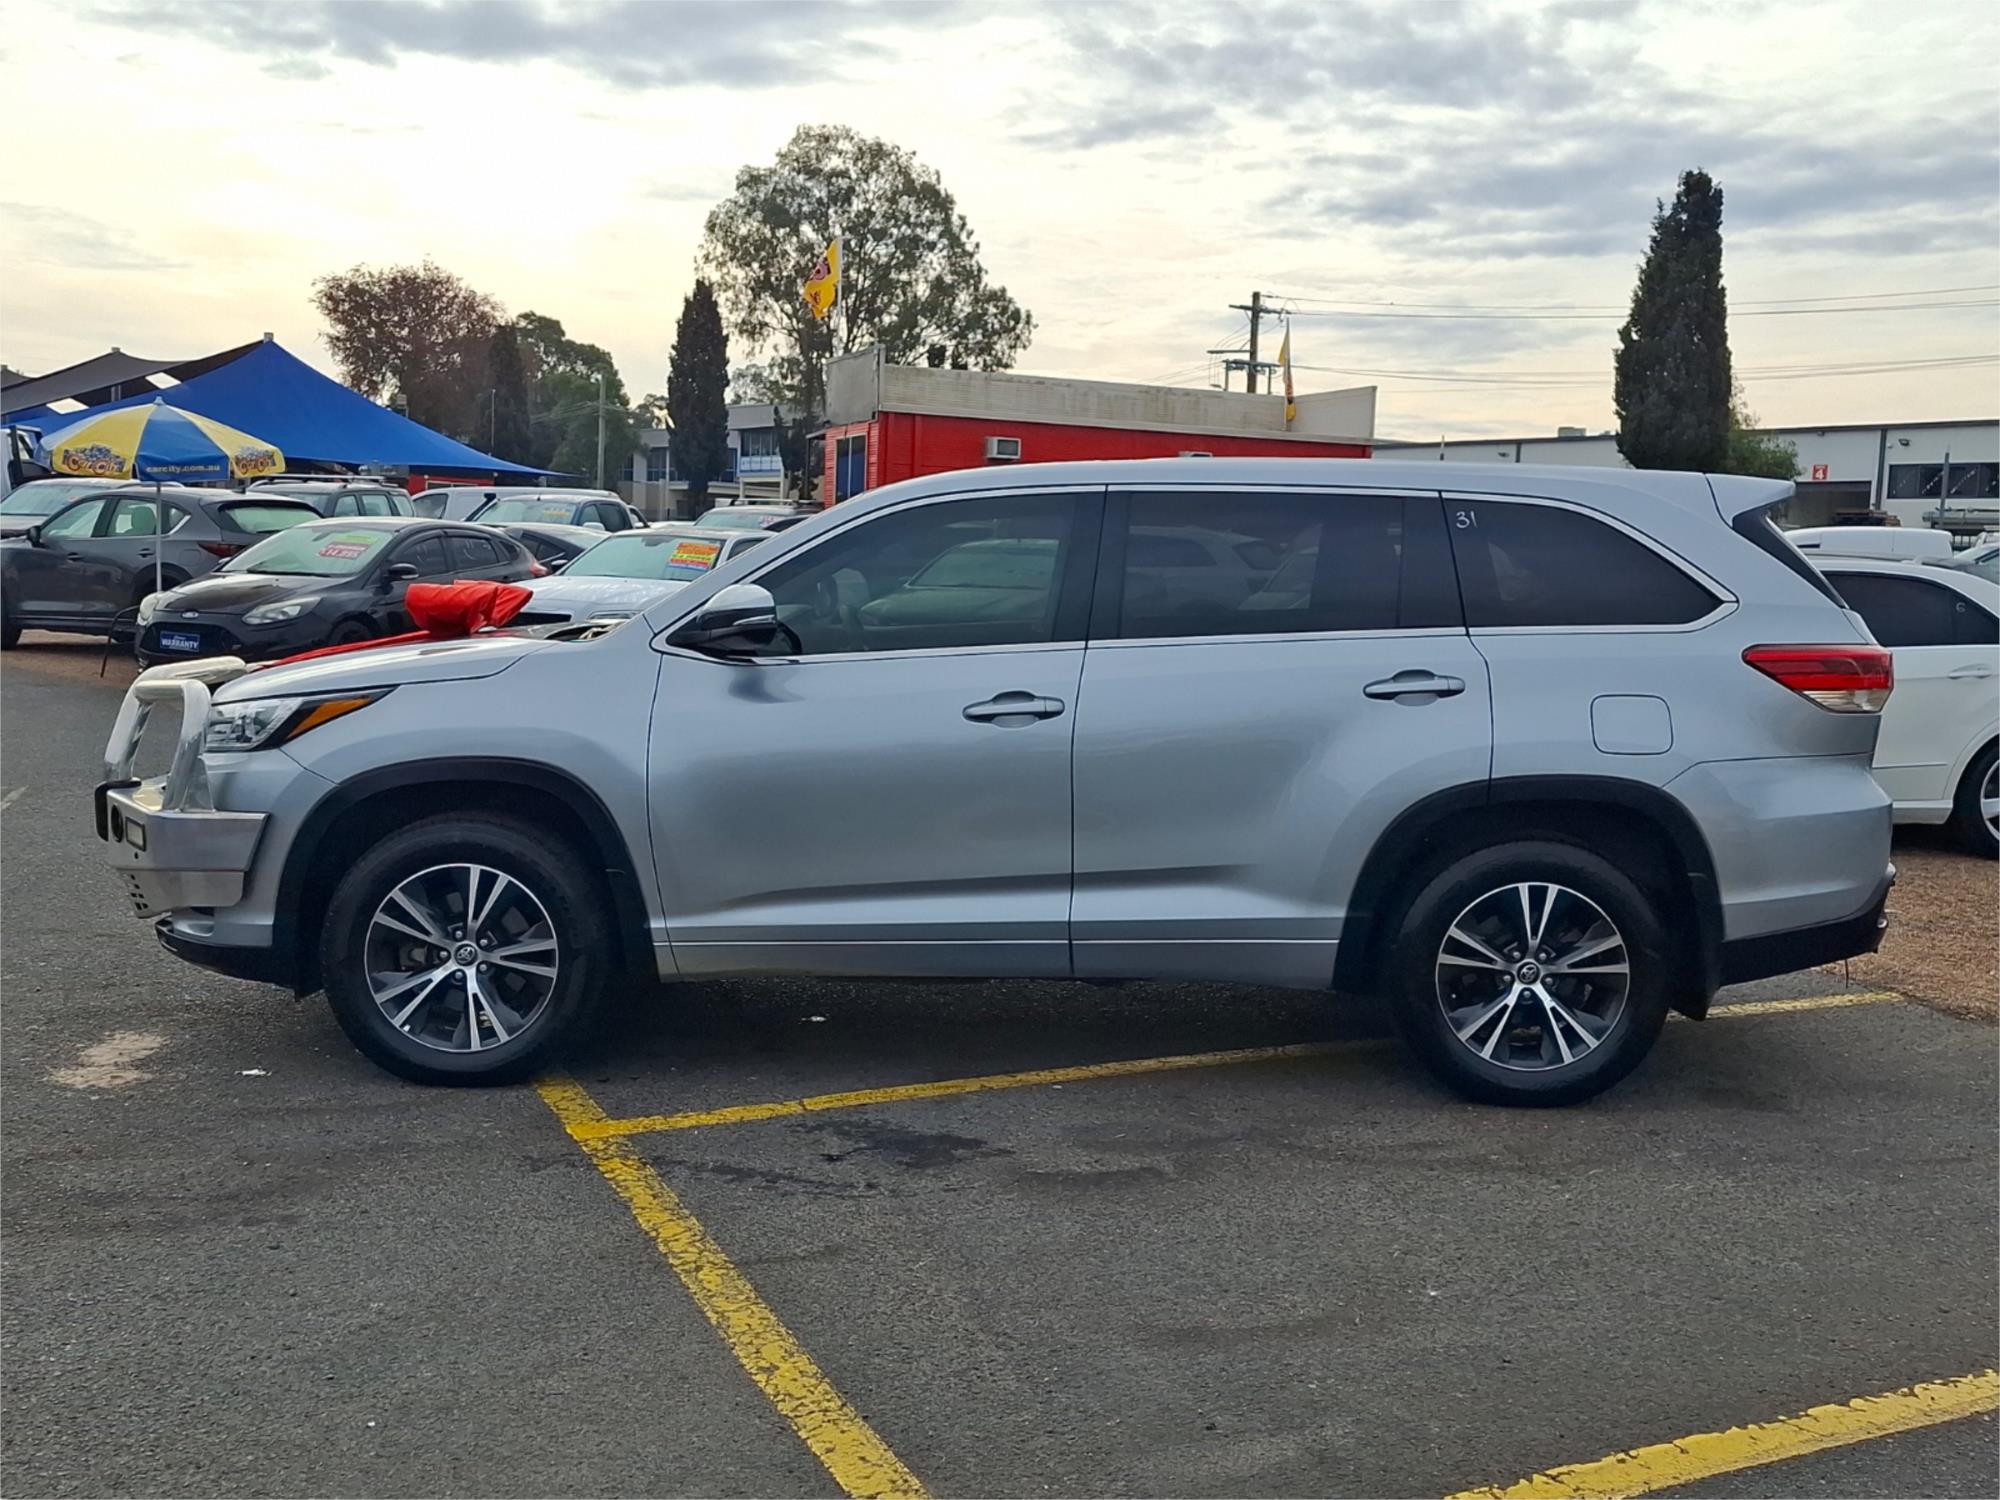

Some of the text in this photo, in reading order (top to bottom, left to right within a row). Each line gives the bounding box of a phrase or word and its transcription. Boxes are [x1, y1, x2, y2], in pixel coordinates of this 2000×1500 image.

[145, 465, 220, 474] carcity.com.au
[1815, 469, 1825, 480] 4
[1455, 511, 1478, 529] 31
[161, 639, 199, 649] WARRANTY
